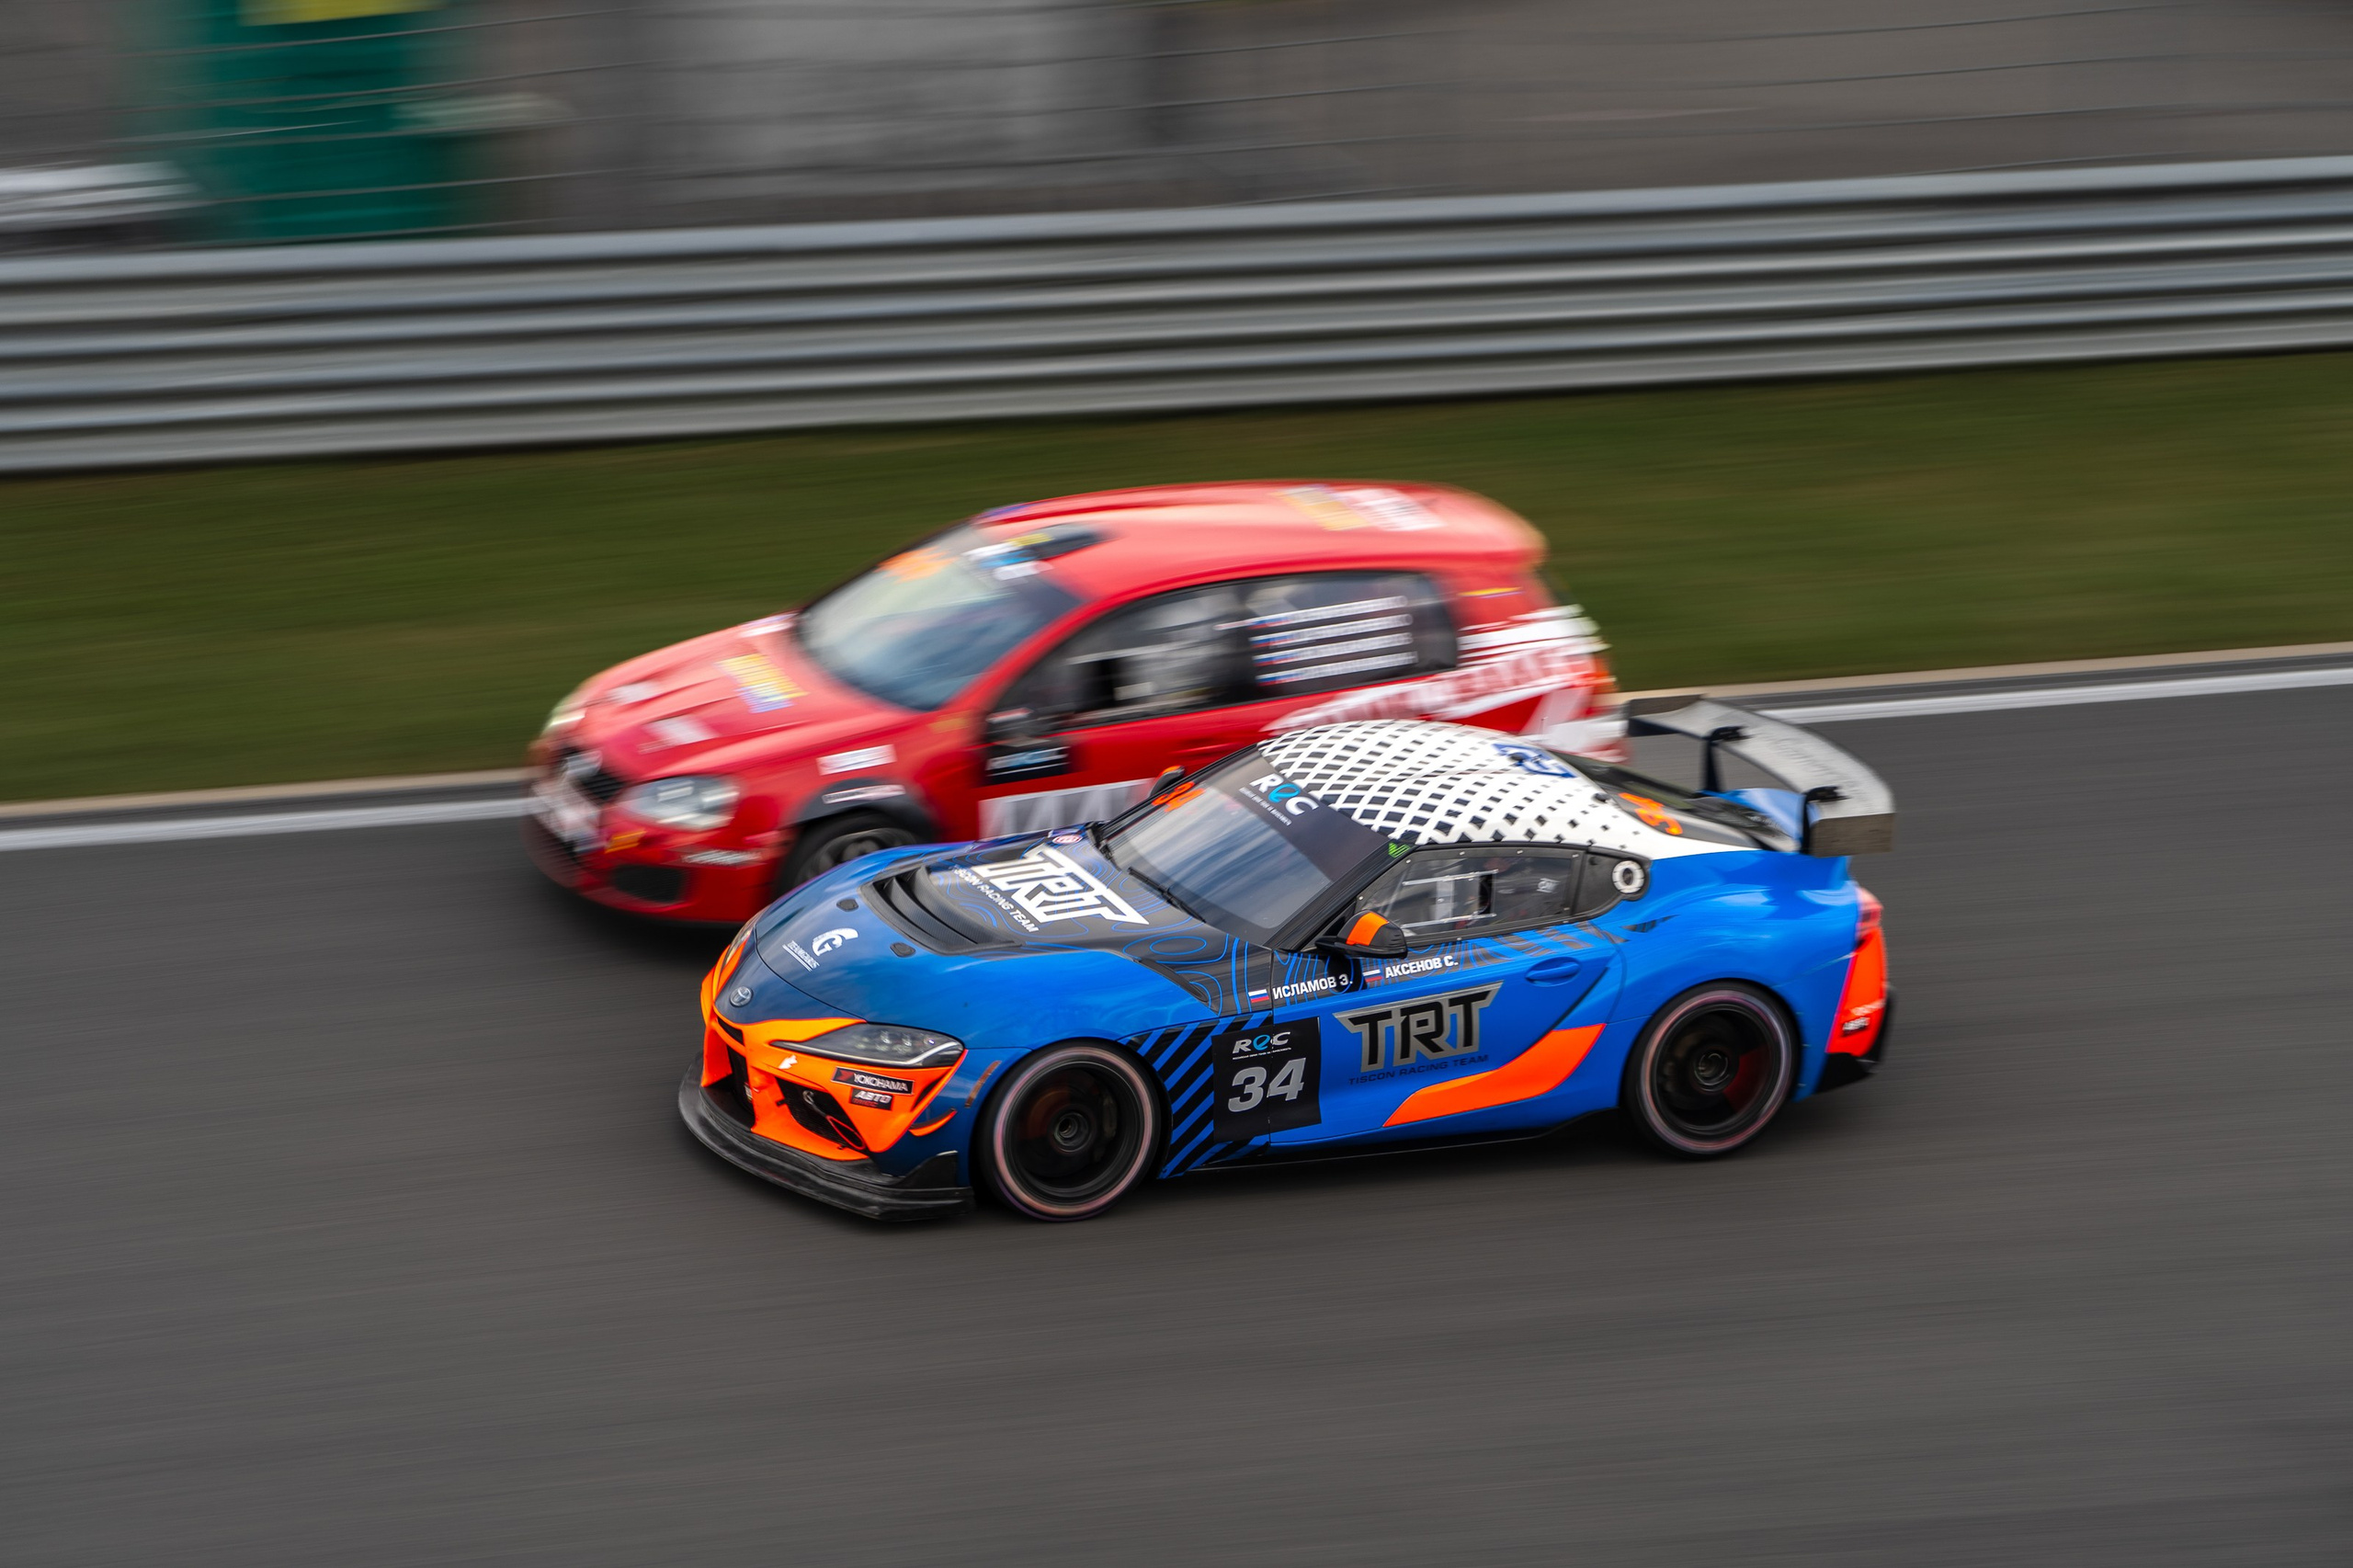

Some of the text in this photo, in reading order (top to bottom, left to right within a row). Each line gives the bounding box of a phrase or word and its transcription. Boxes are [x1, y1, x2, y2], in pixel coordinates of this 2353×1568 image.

[1151, 781, 1206, 812] 34
[970, 844, 1149, 925] TRT
[977, 884, 1014, 910] RACING
[1010, 910, 1040, 932] TEAM
[1385, 955, 1459, 979] АКСЕНОВ С.
[1272, 976, 1336, 1000] ИСЛАМОВ
[1333, 981, 1504, 1074] TRT
[854, 1073, 908, 1092] YOKOHAMA
[1228, 1057, 1306, 1112] 34
[1348, 1054, 1489, 1085] TISCON RACING TEAM
